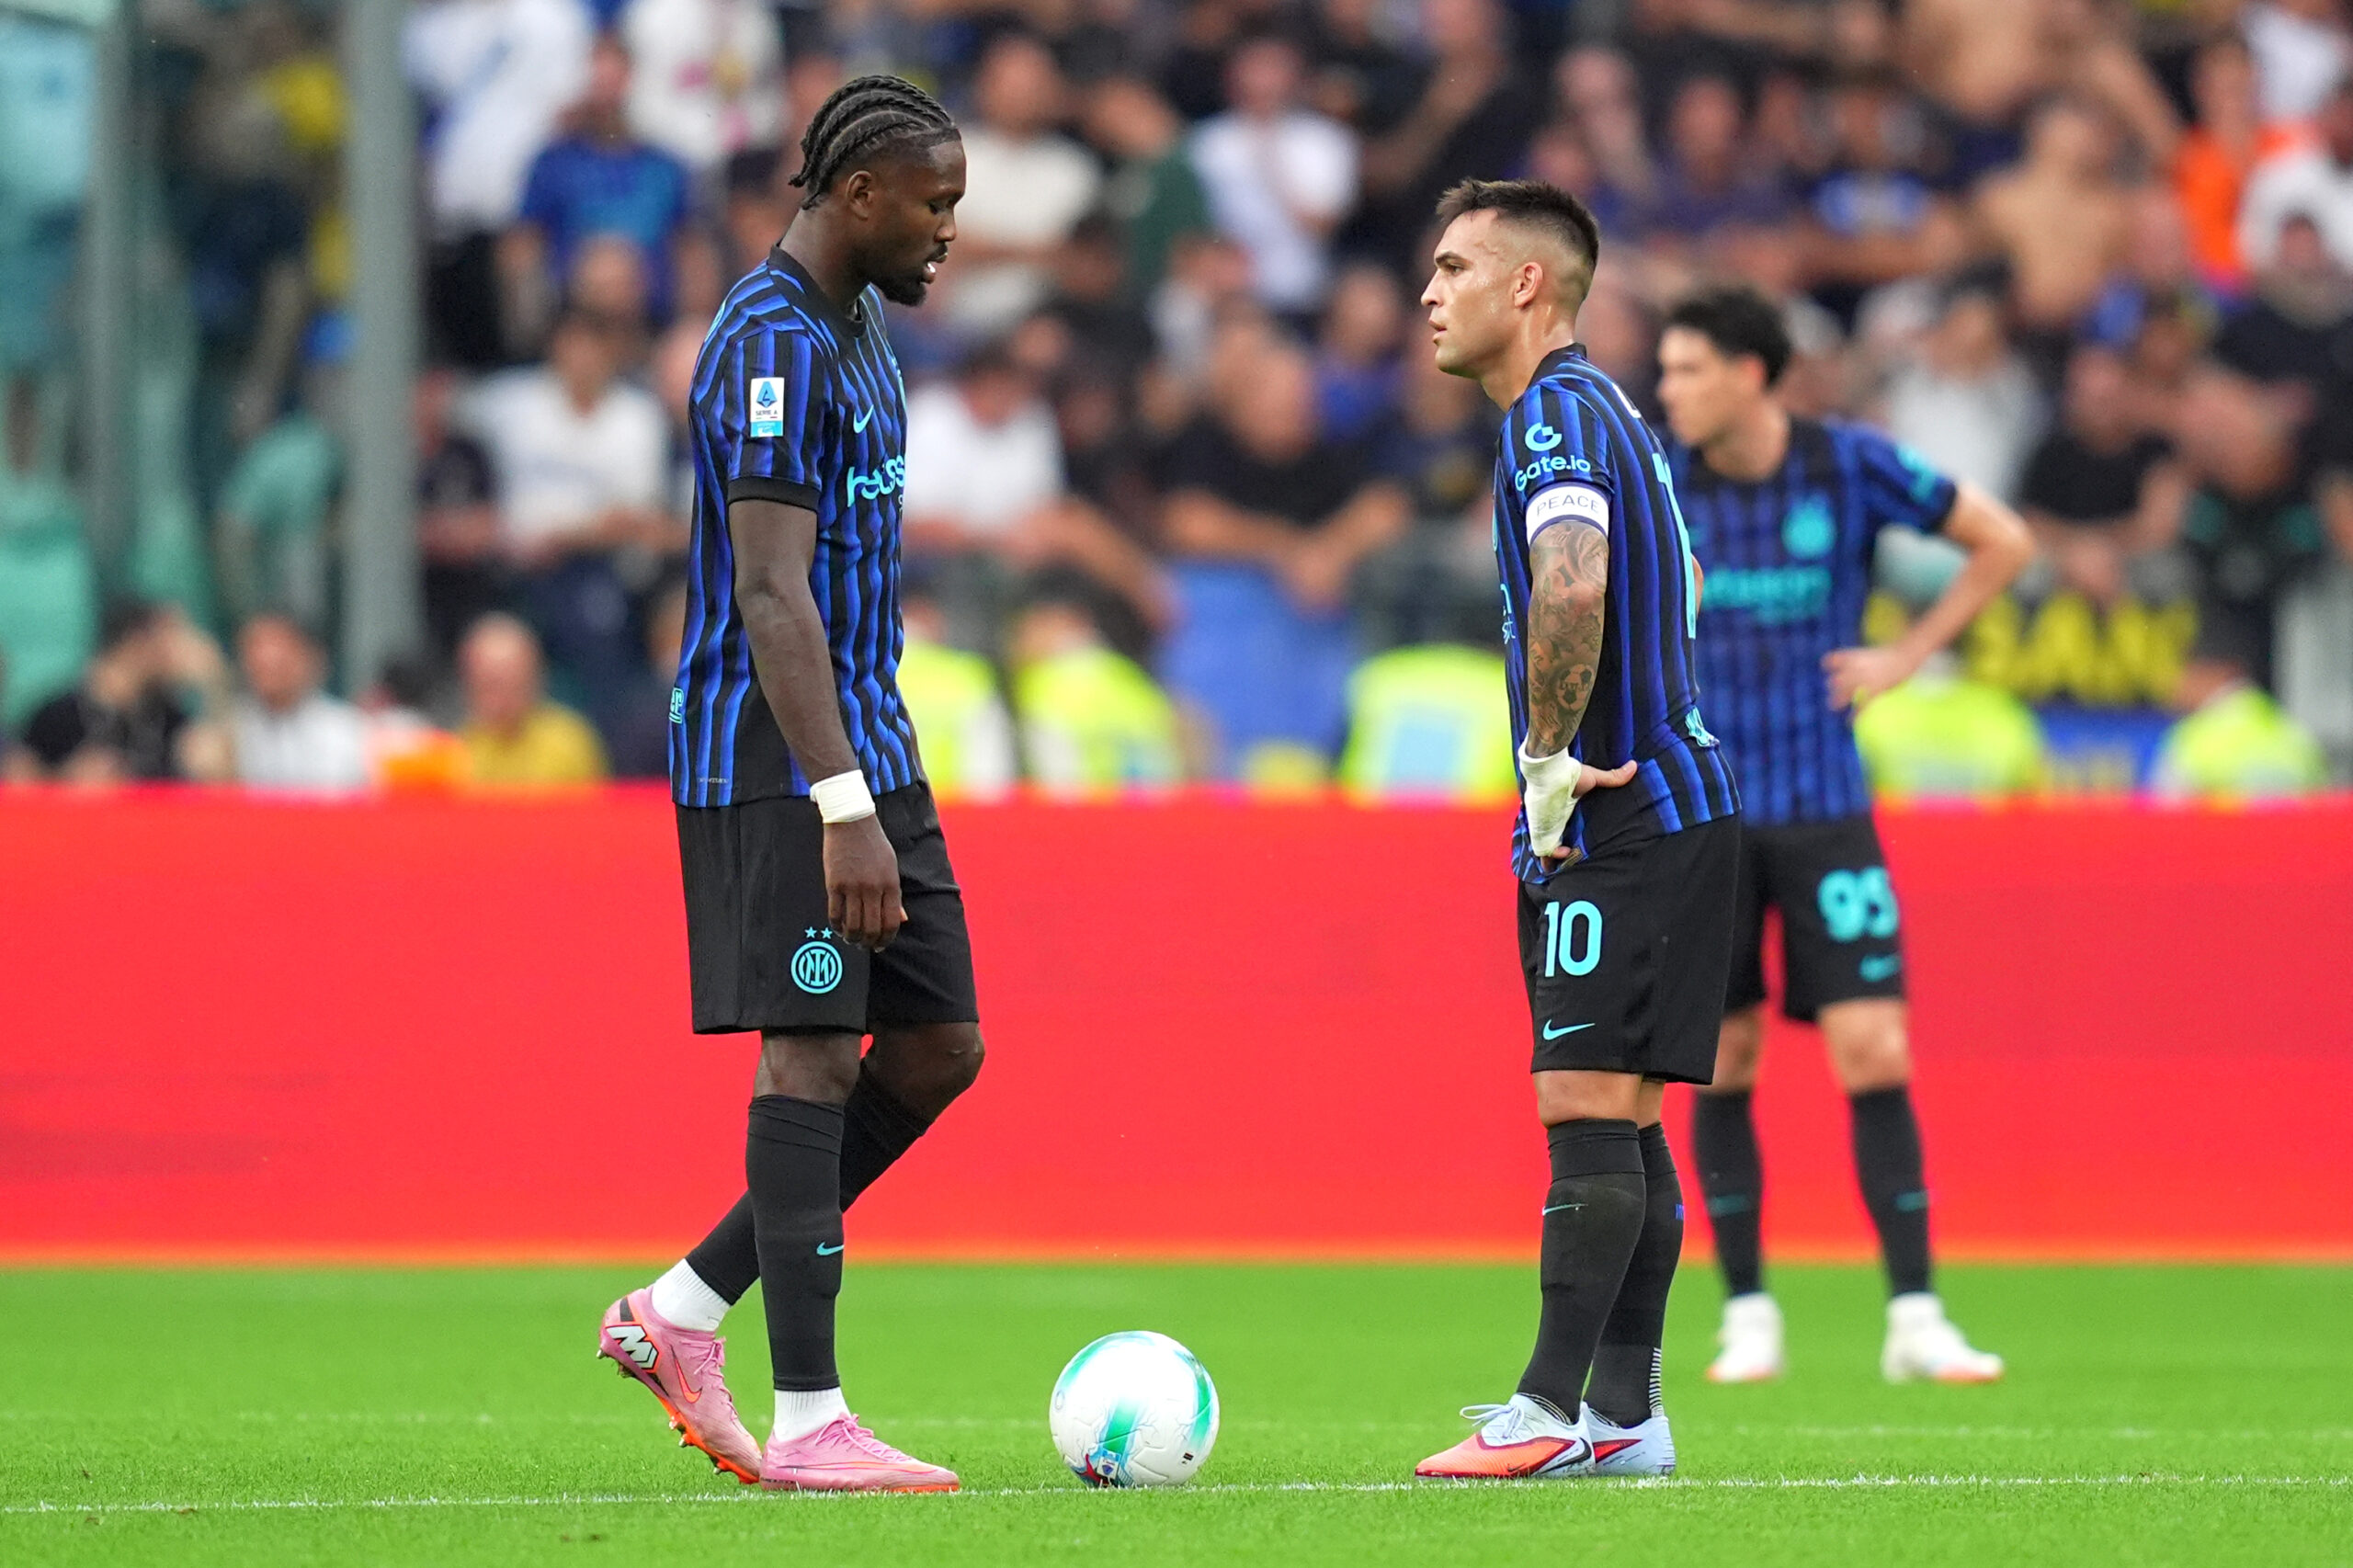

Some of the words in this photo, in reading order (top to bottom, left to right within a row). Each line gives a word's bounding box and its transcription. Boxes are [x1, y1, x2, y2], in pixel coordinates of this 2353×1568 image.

[1515, 454, 1591, 492] Gate.io
[1536, 494, 1600, 517] PEACE
[1544, 900, 1603, 978] 10
